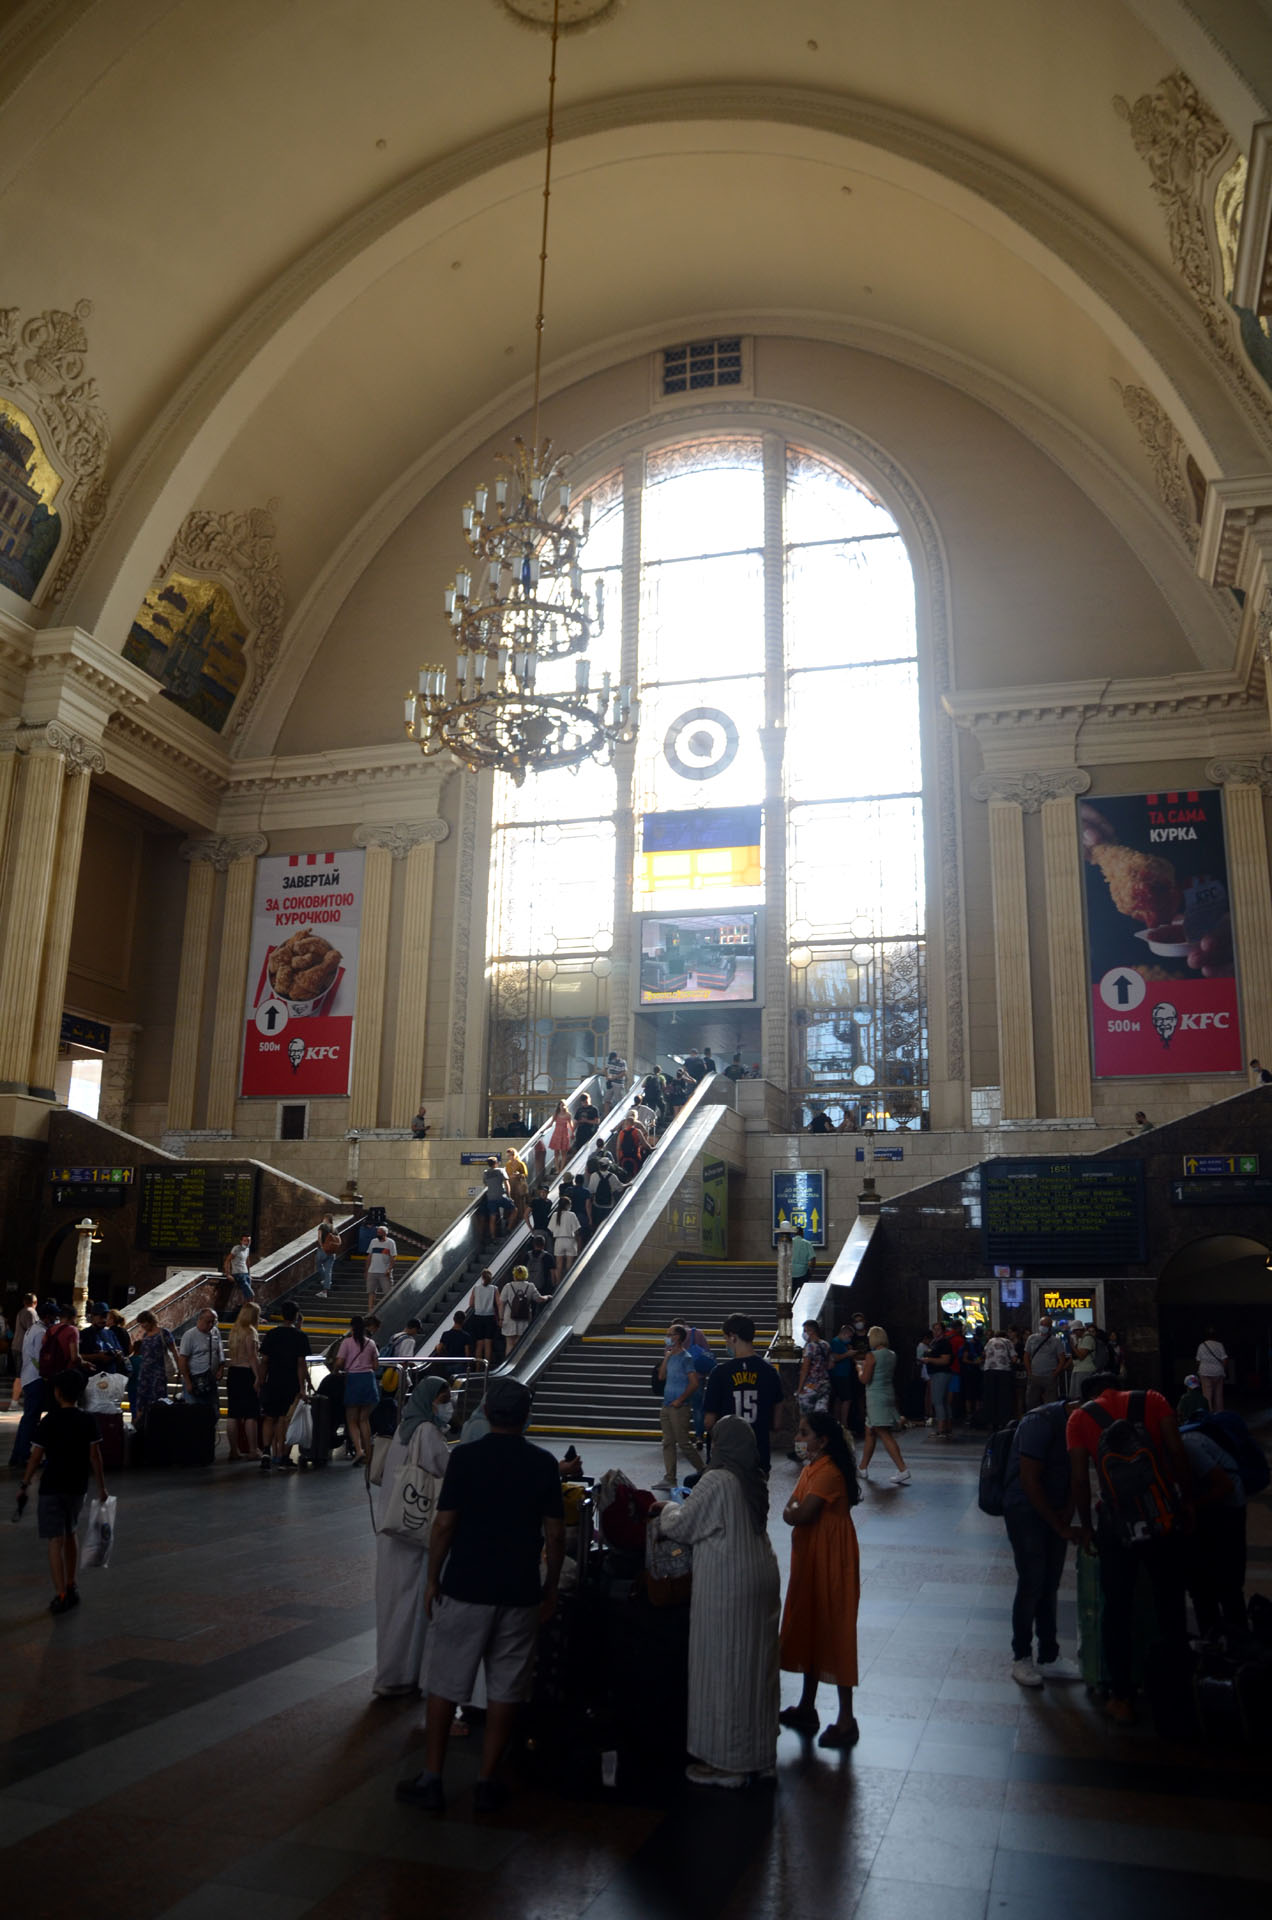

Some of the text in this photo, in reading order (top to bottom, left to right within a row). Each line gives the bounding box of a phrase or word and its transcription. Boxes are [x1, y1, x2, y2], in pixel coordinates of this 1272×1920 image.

[1148, 808, 1207, 825] ТА САМА
[1149, 826, 1197, 843] КУРКА
[282, 868, 339, 889] ЗАВЕРТАЙ
[265, 892, 354, 912] ЗА СОКОВИТОЮ
[275, 909, 341, 926] КУРОЧКОЮ
[1179, 1011, 1230, 1030] KFC
[305, 1045, 340, 1060] KFC
[1226, 1156, 1235, 1173] 1
[92, 1168, 99, 1183] 1
[56, 1191, 62, 1203] 1
[1175, 1187, 1183, 1201] 1
[793, 1215, 804, 1225] 14
[1045, 1298, 1092, 1309] МАРКЕТ
[732, 1389, 758, 1424] 15
